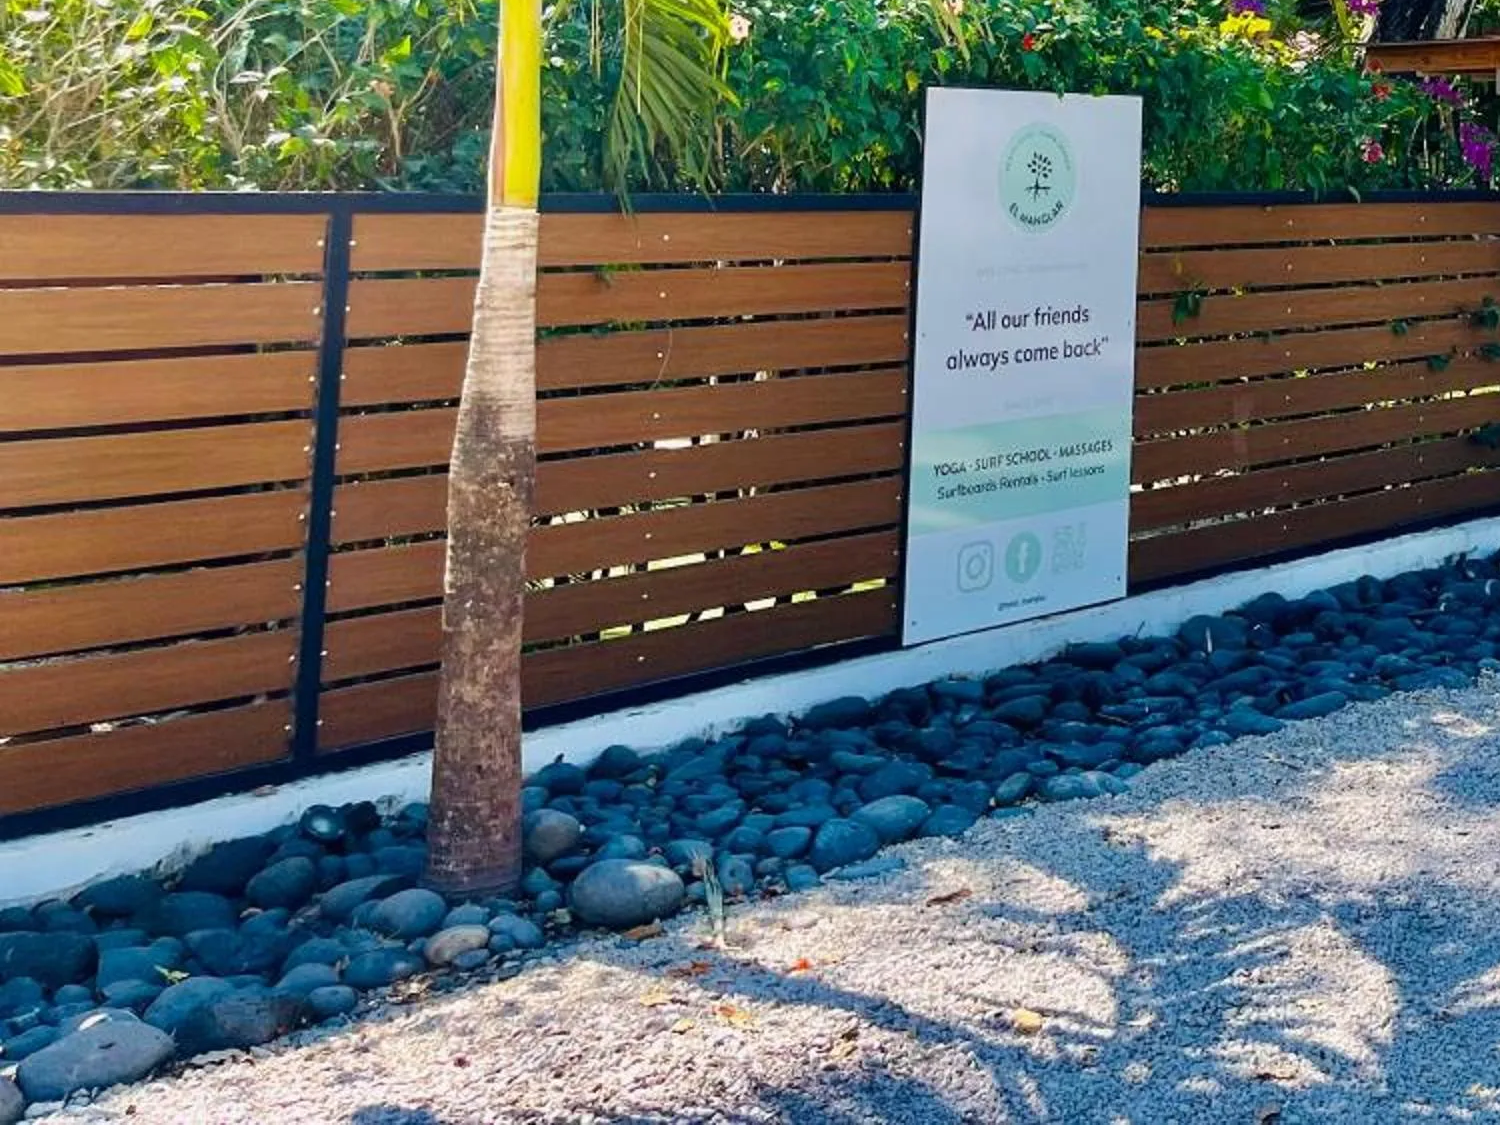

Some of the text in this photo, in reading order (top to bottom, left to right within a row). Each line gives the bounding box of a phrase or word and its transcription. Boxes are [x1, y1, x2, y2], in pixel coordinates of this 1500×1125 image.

[1001, 313, 1030, 329] our
[1034, 305, 1089, 326] friends
[946, 349, 1009, 371] always
[1014, 346, 1059, 364] come
[933, 439, 1113, 477] YOGA SURF SCHOOL MASSAGES
[937, 479, 997, 500] Surfboards
[1000, 473, 1039, 489] Rentals
[1047, 467, 1069, 483] Surf
